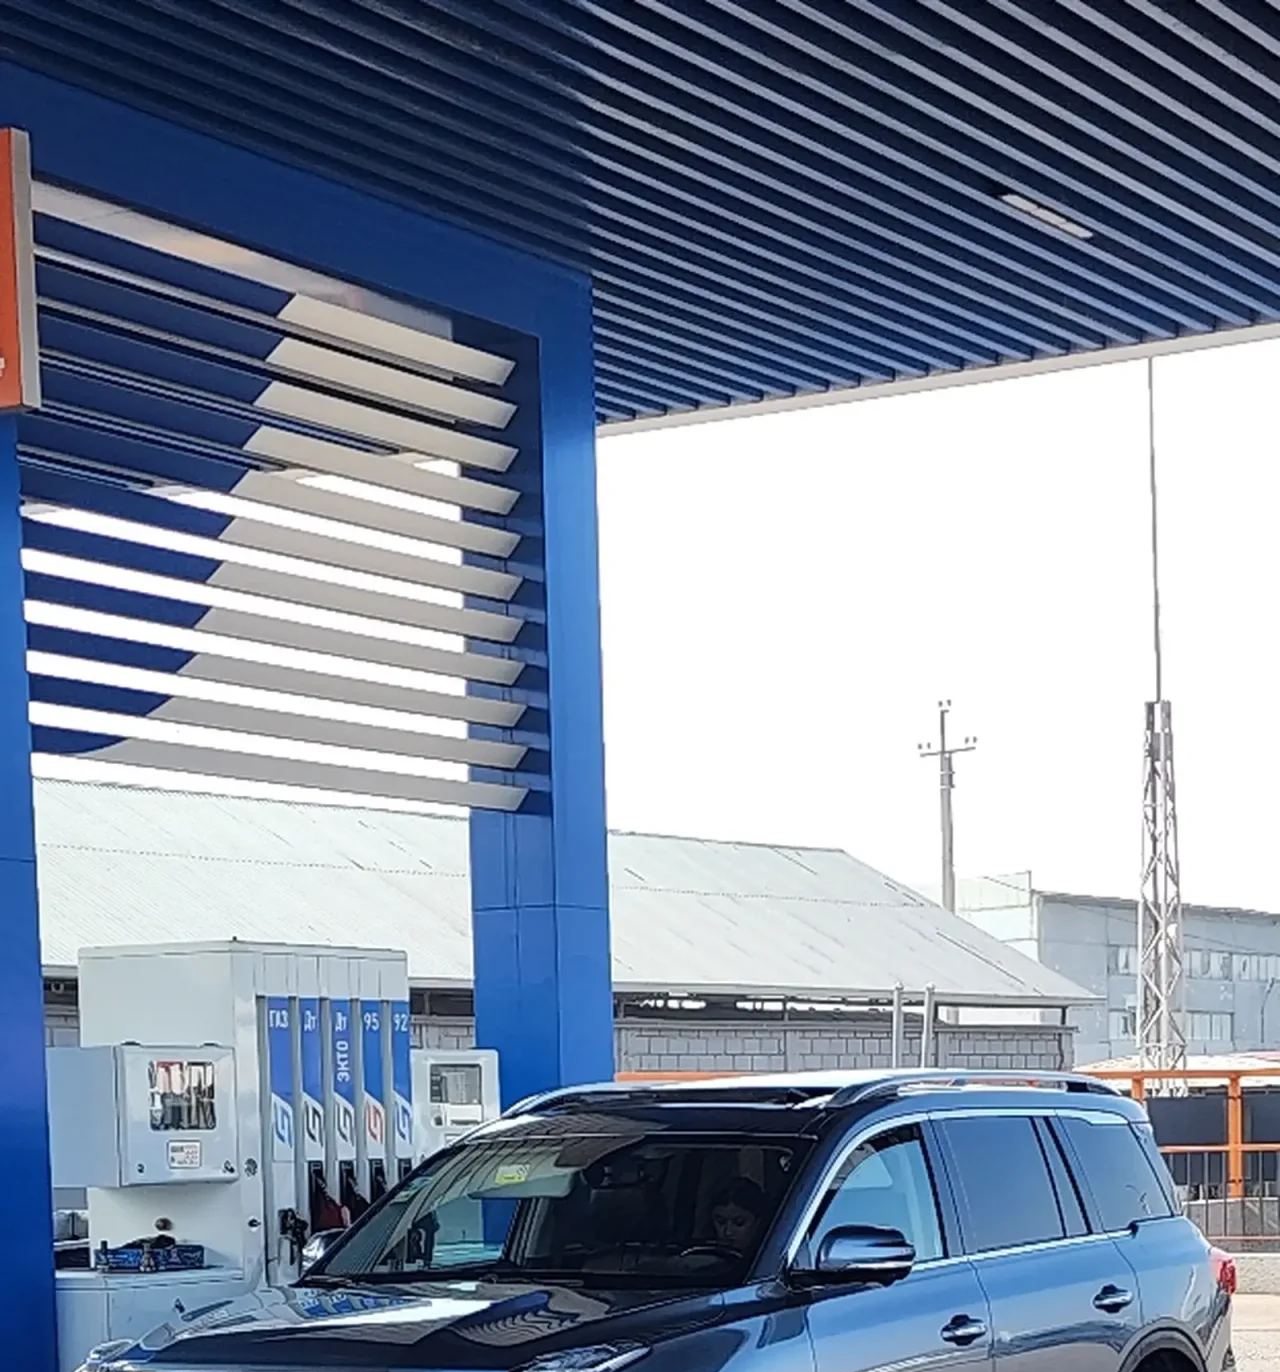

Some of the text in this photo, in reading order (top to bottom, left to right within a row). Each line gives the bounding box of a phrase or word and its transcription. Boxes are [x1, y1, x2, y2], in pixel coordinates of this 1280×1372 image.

[269, 1010, 289, 1028] ГАЗ
[363, 1012, 379, 1031] 95
[393, 1013, 408, 1031] 92
[336, 1040, 350, 1082] ЭКТО
